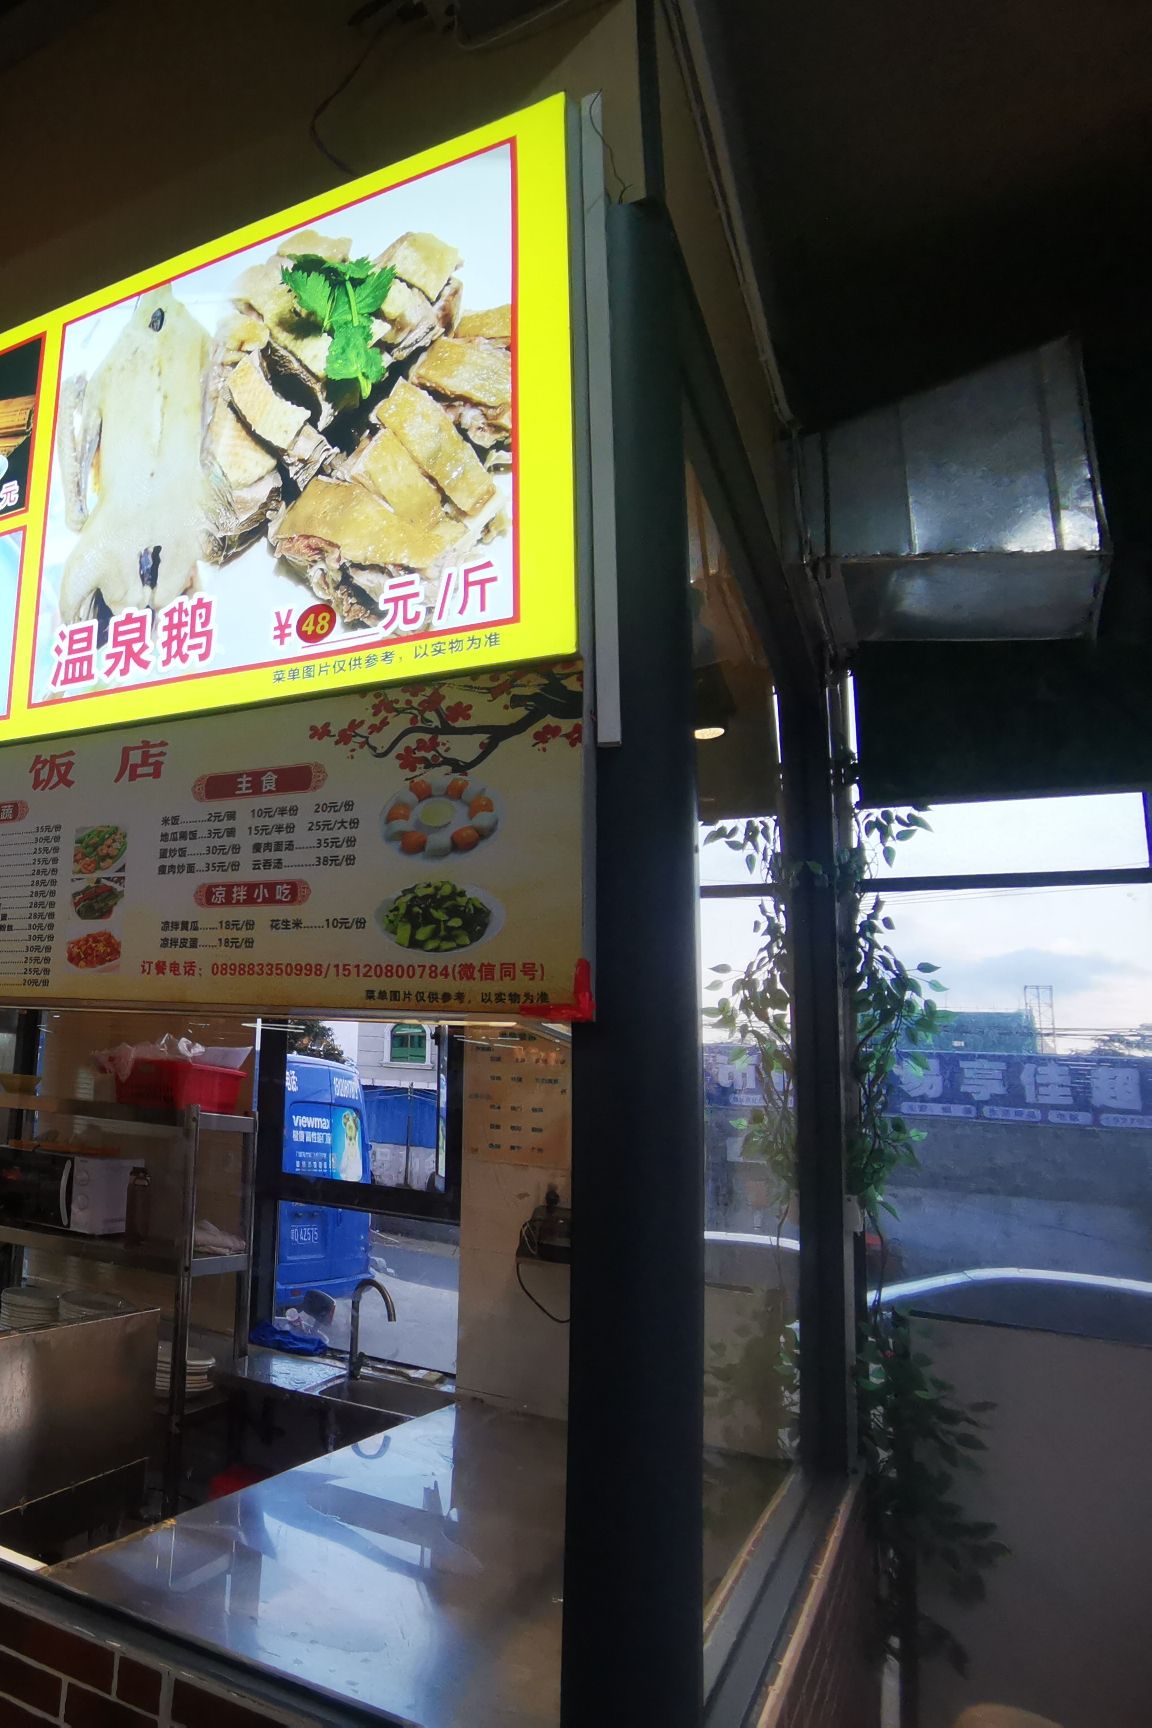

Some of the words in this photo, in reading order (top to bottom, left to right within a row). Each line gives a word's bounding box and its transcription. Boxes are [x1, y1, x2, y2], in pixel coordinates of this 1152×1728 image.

[0, 481, 20, 508] 元
[51, 597, 214, 688] 温泉鹅
[273, 609, 294, 646] ¥
[301, 612, 332, 637] 48
[383, 560, 499, 630] 元/斤
[272, 633, 501, 685] 菜单图片仅供参考，以实物为准
[234, 771, 278, 794] 主食
[160, 815, 180, 827] 米饭
[250, 804, 299, 819] 10元/半份
[314, 800, 355, 813] 20元/份
[35, 824, 63, 833] 35元/份
[247, 823, 296, 837] 15元/半份
[307, 818, 360, 832] 25元/大份
[34, 835, 61, 843] 30元/份
[33, 846, 60, 855] 25元/份
[158, 847, 188, 860] 蛋炒饭
[205, 844, 241, 856] 30元/份
[251, 841, 295, 854] 瘦肉面汤
[316, 836, 357, 850] 35元/份
[32, 856, 60, 865] 25元/份
[157, 863, 196, 876] 瘦肉炒面
[204, 861, 240, 873] 35元/份
[251, 858, 284, 871] 云吞汤
[315, 855, 356, 868] 38元/份
[31, 867, 59, 876] 28元/份
[30, 878, 58, 887] 28元/份
[29, 889, 57, 898] 28元/份
[210, 884, 292, 904] 凉拌小吃
[28, 901, 56, 909] 28元/份
[28, 911, 55, 920] 28元/份
[28, 922, 55, 931] 30元/份
[159, 920, 200, 932] 凉拌黄瓜
[219, 919, 256, 932] 18元/份
[269, 918, 303, 931] 花生米
[325, 917, 367, 930] 10元/份
[28, 934, 55, 942] 30元/份
[159, 937, 199, 950] 凉拌皮蛋
[218, 937, 255, 949] 18元/份
[25, 945, 52, 953] 30元/份
[24, 956, 51, 964] 25元/份
[23, 967, 51, 975] 25元/份
[22, 978, 50, 987] 20元/份
[364, 989, 550, 1004] 菜单图片仅供参考，以实物为准
